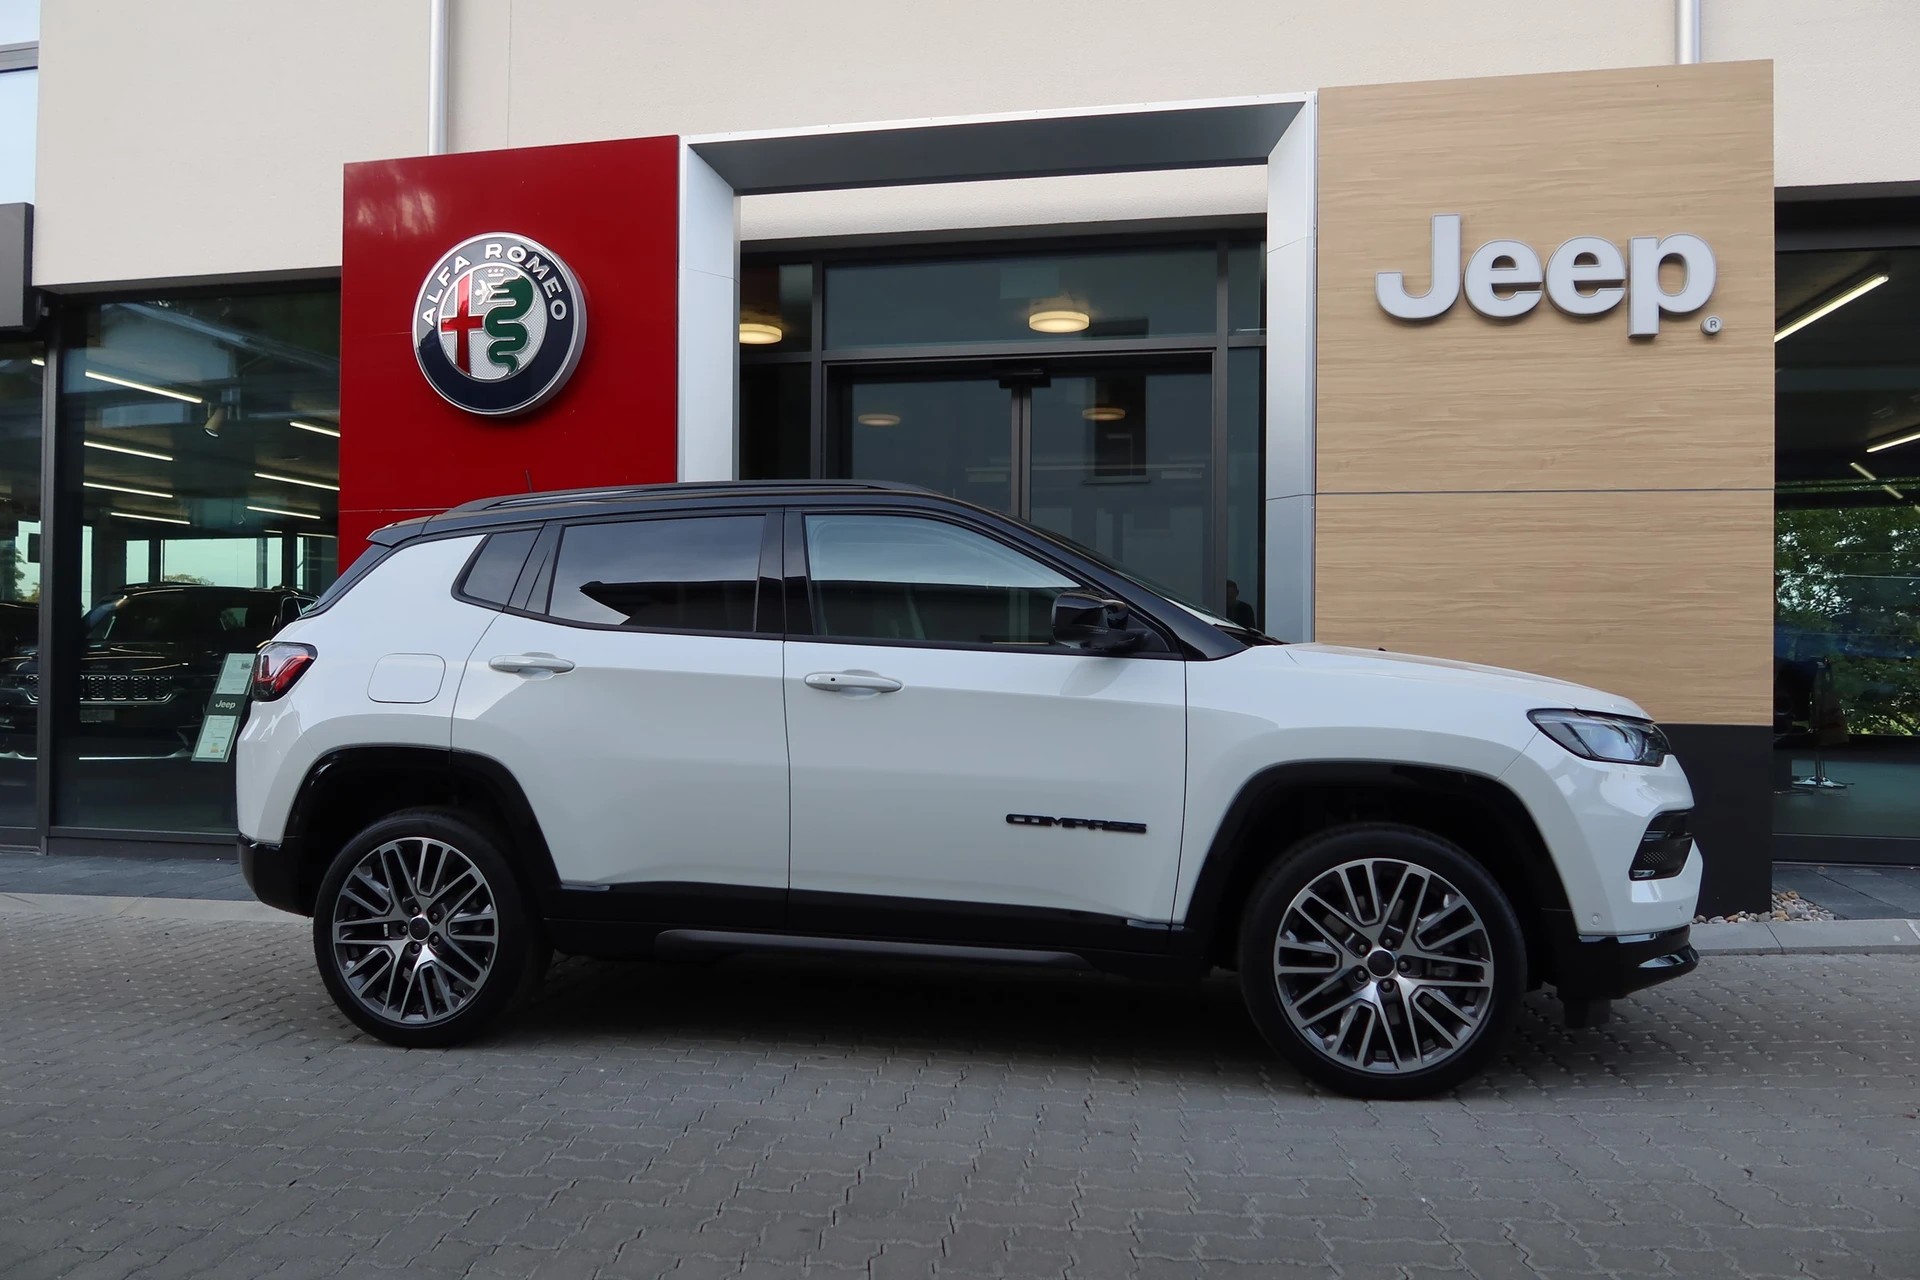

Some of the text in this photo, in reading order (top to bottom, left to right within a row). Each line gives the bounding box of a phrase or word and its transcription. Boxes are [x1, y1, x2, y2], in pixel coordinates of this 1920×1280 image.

[422, 243, 567, 327] ALFA ROMEO
[1375, 213, 1717, 339] Jeep
[215, 699, 236, 710] Jeep
[1006, 813, 1147, 834] COMPASS
